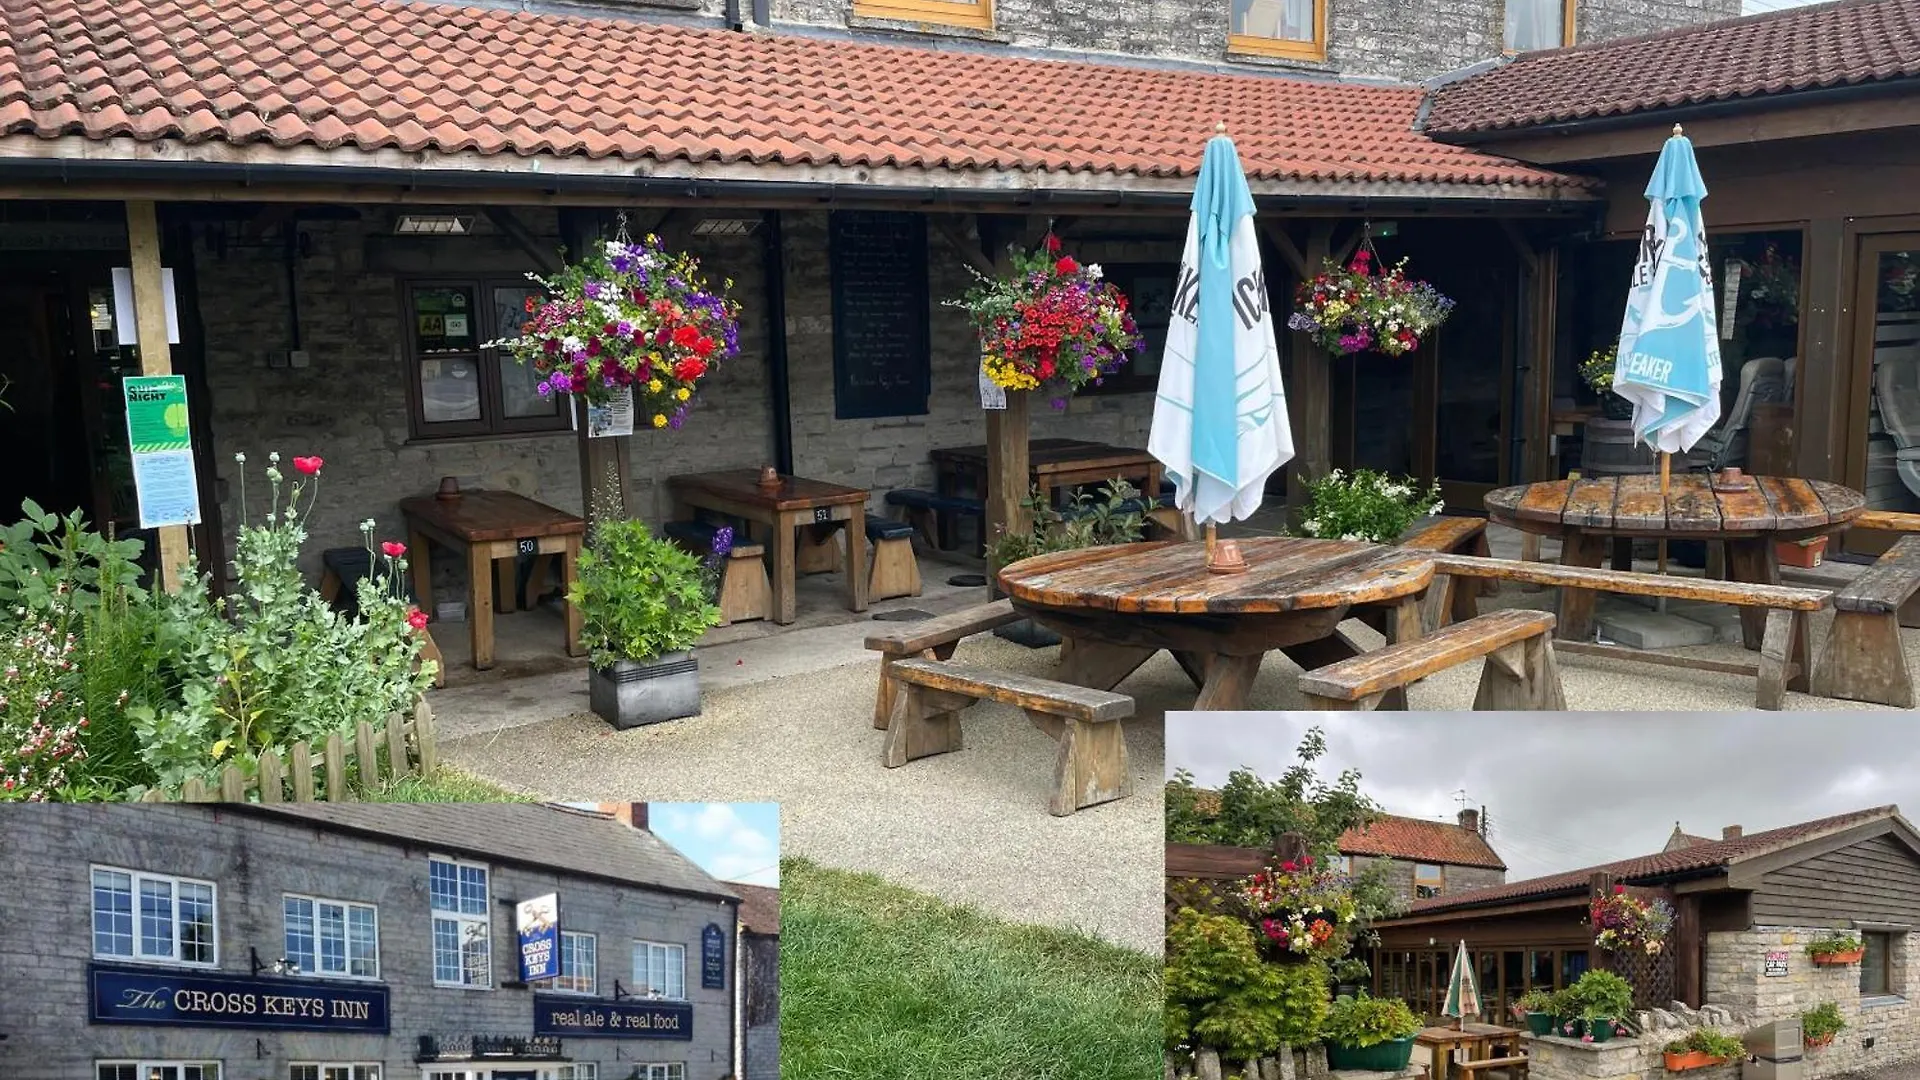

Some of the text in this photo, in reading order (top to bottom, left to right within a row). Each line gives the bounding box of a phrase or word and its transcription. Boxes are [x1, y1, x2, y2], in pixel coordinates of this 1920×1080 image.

[1629, 352, 1673, 384] EAKER
[128, 393, 166, 401] NIGHT
[816, 509, 829, 521] 51
[520, 540, 534, 553] 50
[522, 939, 552, 954] CROSS
[525, 951, 549, 966] KEYS
[529, 963, 546, 975] INN
[115, 986, 370, 1020] The CROSS KEYS INN
[551, 1009, 679, 1029] real ale & real food
